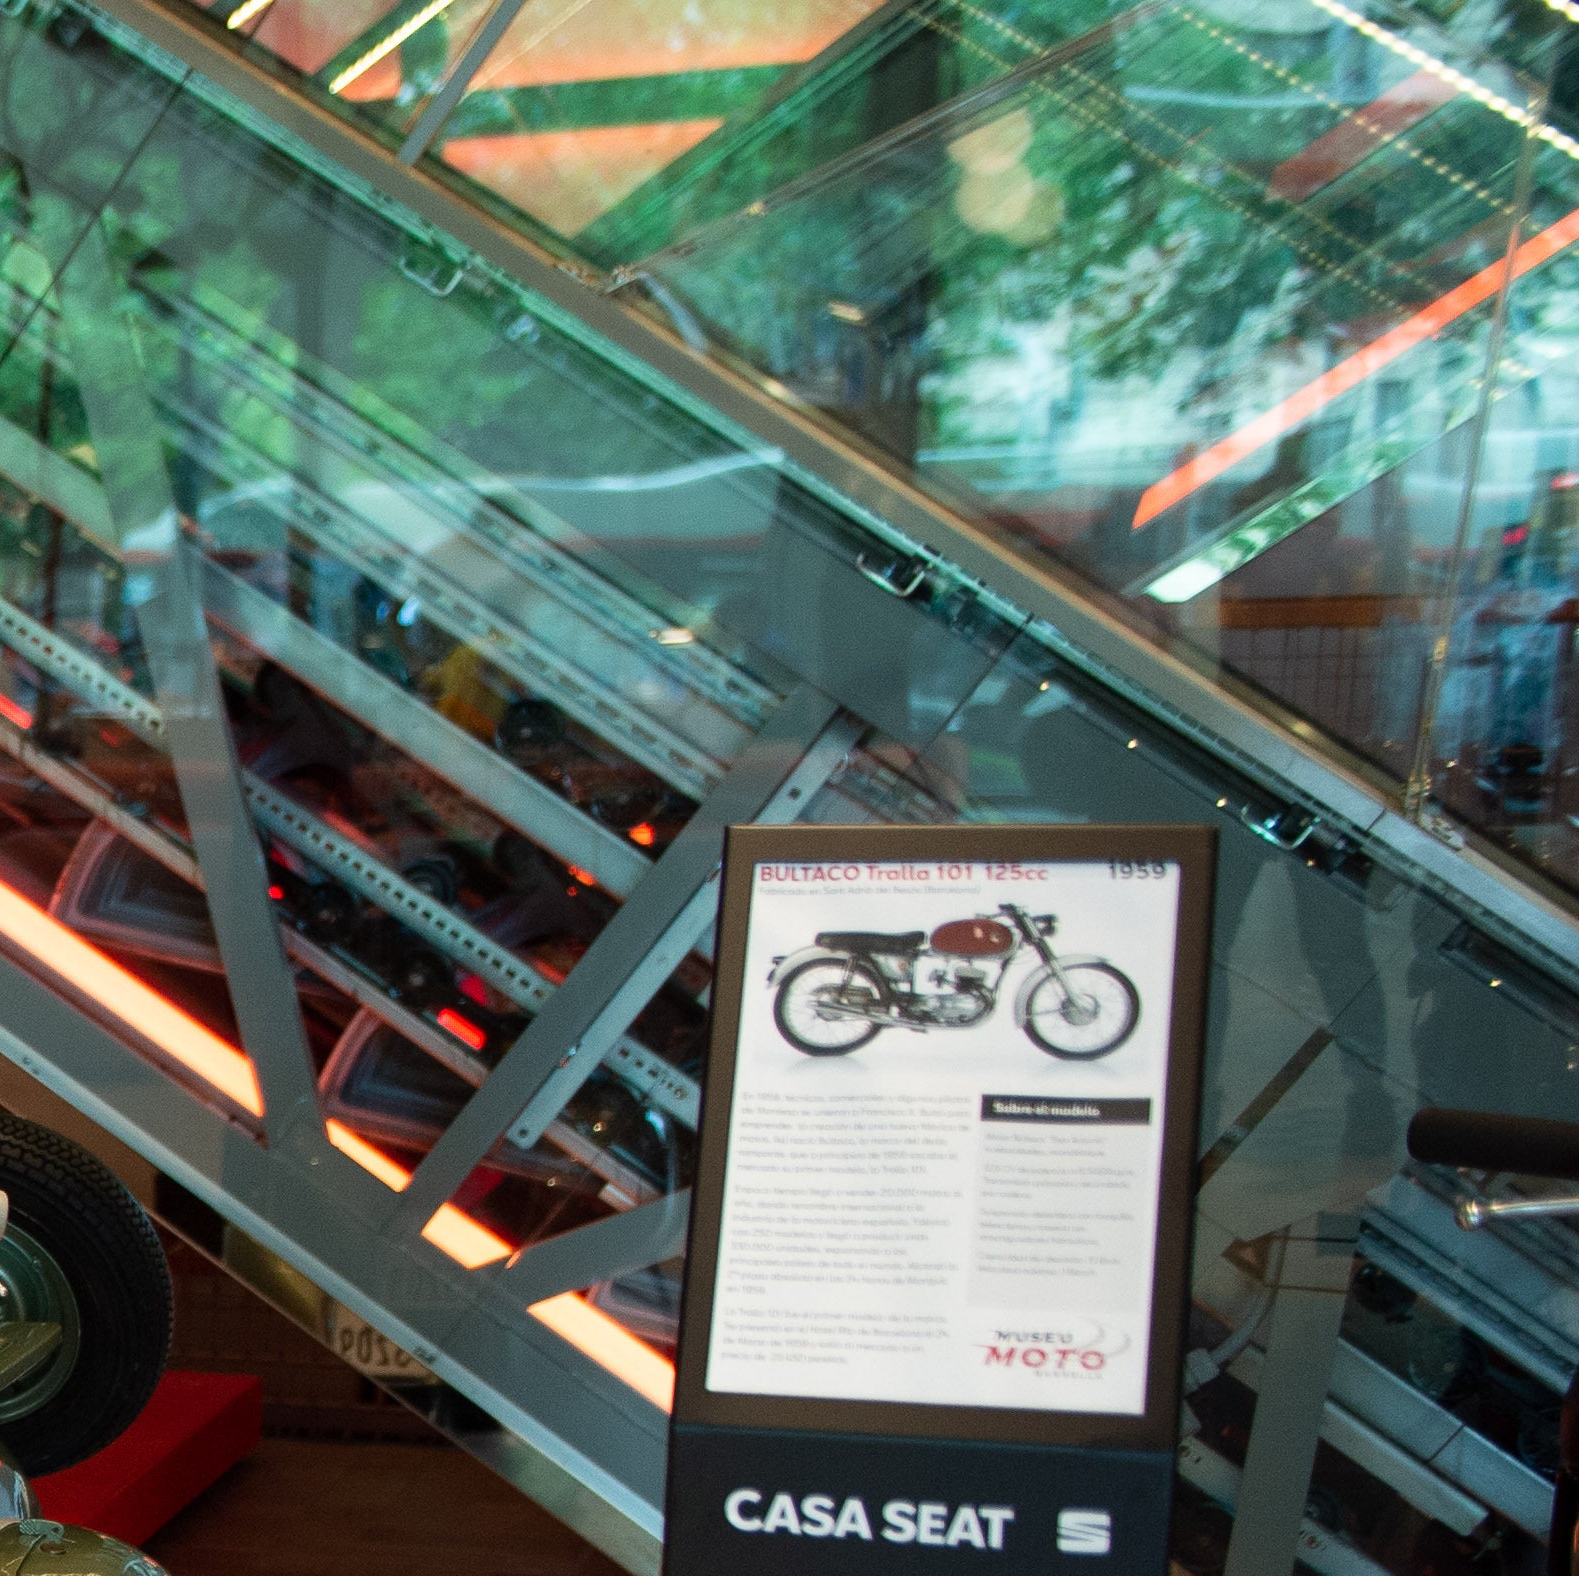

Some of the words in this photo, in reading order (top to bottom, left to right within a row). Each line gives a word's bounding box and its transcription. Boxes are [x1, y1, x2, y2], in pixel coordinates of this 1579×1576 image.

[759, 864, 859, 882] BULTACO
[868, 864, 930, 882] Tralla
[937, 864, 973, 882] 101
[985, 864, 1049, 882] 125cc
[1107, 863, 1167, 880] 1959
[994, 1101, 1034, 1117] Sobre
[1037, 1102, 1053, 1117] el
[1054, 1103, 1100, 1117] modelo
[992, 1329, 1073, 1344] MUSEU
[979, 1345, 1106, 1371] MOTO
[723, 1488, 874, 1542] CASA
[881, 1498, 1015, 1551] SEAT
